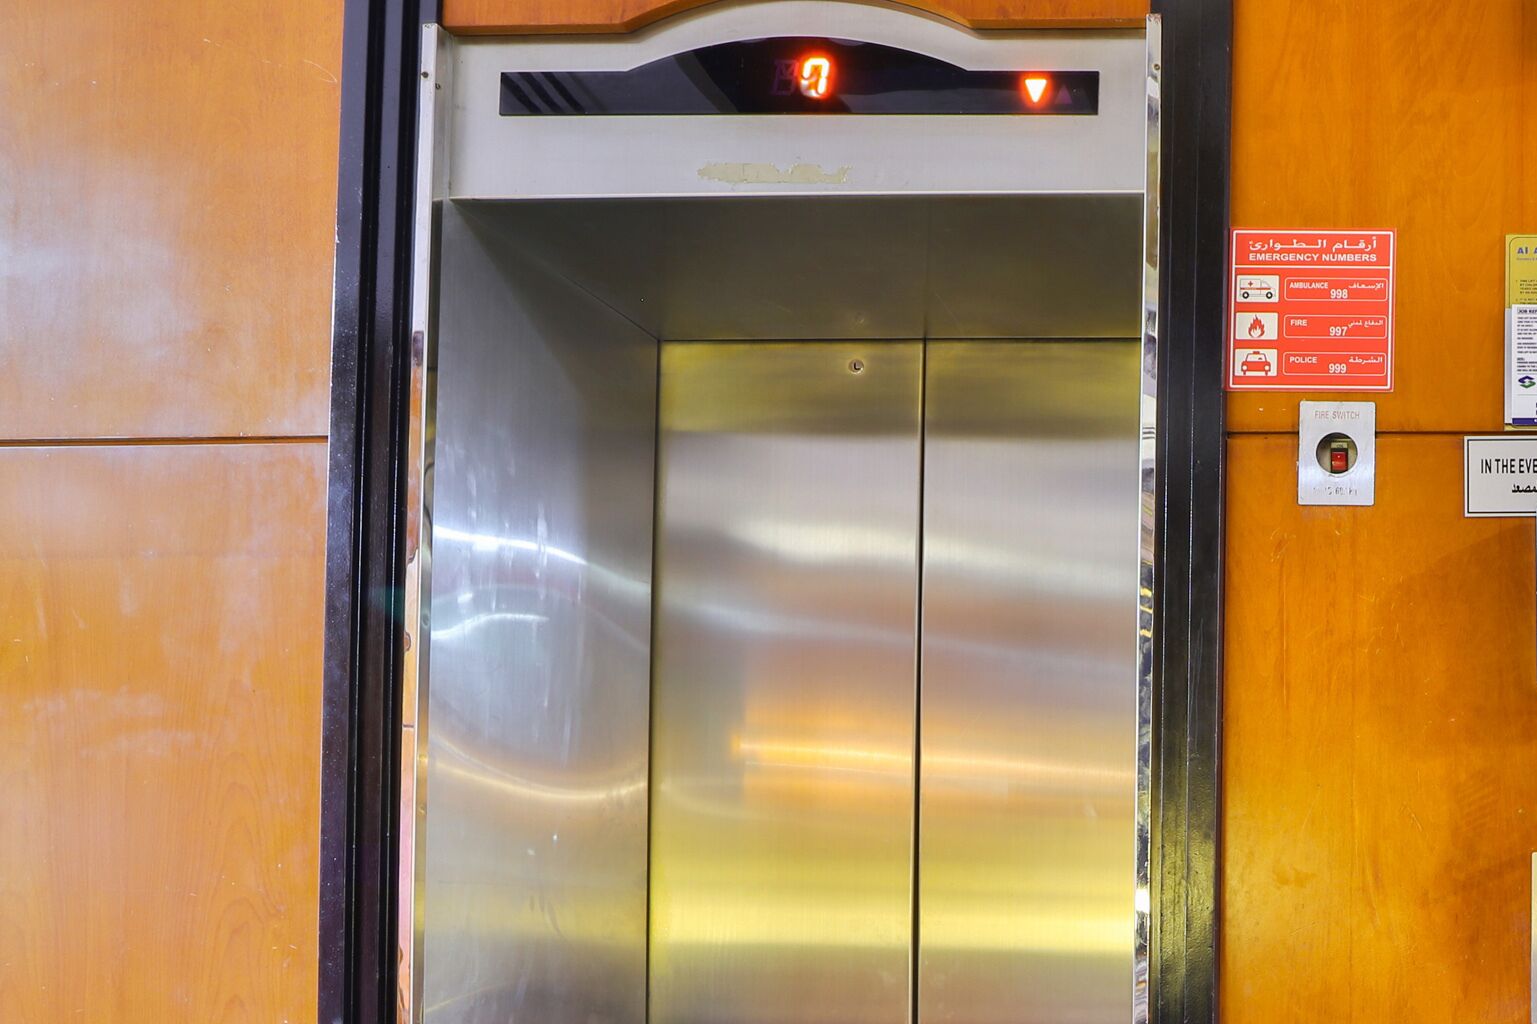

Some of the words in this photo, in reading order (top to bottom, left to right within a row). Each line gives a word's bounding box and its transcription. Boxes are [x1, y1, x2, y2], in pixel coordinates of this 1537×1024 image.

[1248, 239, 1326, 251] الطوارئ
[1332, 236, 1377, 252] أرقام
[1517, 246, 1528, 254] Al
[1249, 252, 1319, 261] EMERGENCY
[1322, 253, 1376, 262] NUMBERS
[1330, 289, 1348, 299] 998
[1329, 326, 1348, 336] 997
[1348, 356, 1383, 364] الشرطة
[1328, 364, 1347, 374] 999
[1315, 410, 1329, 420] FIRE
[1332, 410, 1360, 420] SWITCH
[1481, 458, 1492, 473] IN
[1495, 458, 1515, 473] THE
